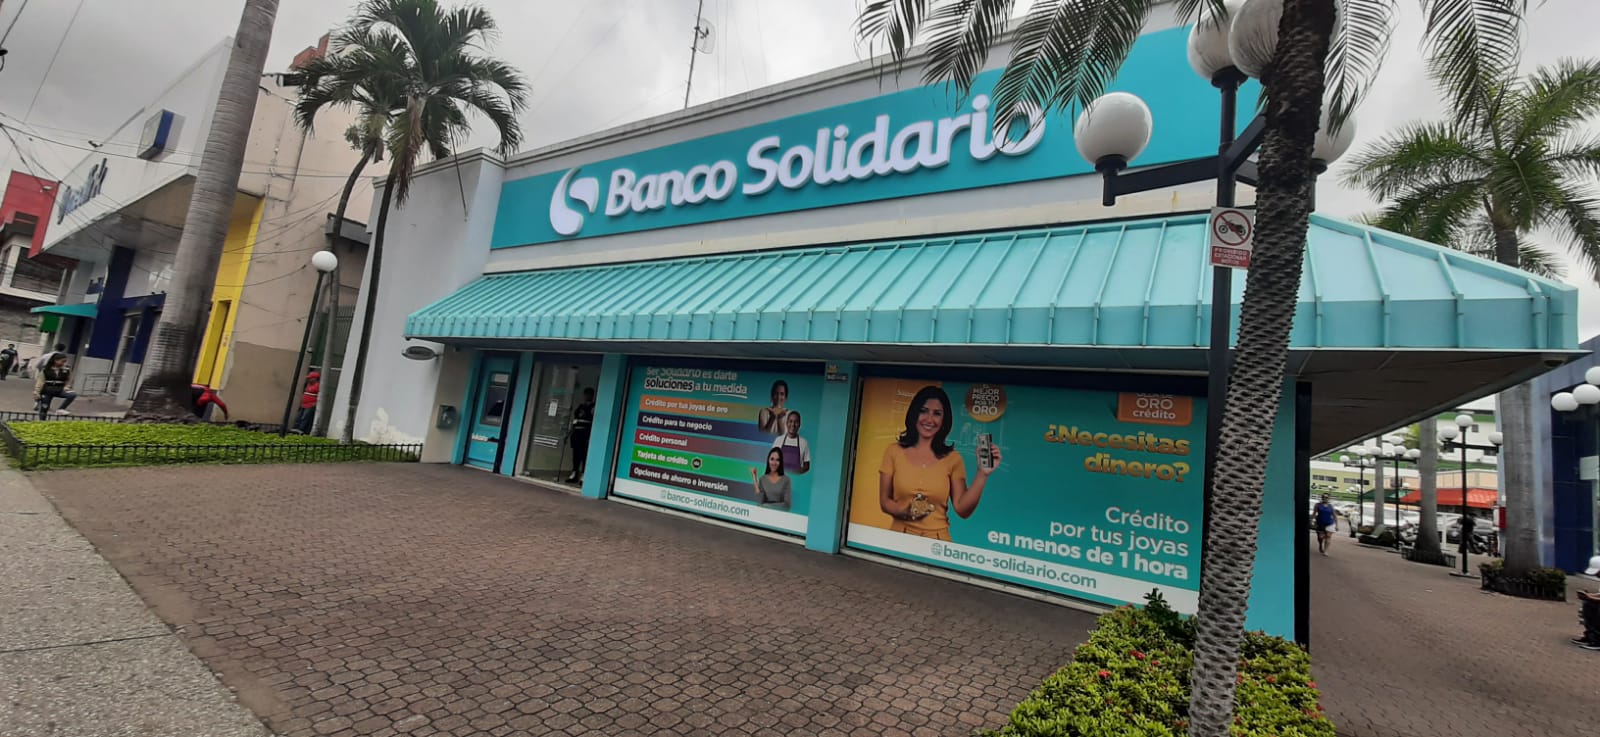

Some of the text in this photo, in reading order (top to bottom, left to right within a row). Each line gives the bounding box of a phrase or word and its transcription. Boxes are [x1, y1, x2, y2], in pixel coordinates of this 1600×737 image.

[605, 94, 1046, 216] Banco Solidario
[702, 371, 712, 379] es
[713, 370, 737, 380] darte
[645, 376, 748, 394] soluciones a tu medida
[645, 398, 666, 408] Crédito
[667, 401, 678, 409] por
[688, 402, 706, 412] joyas
[706, 404, 716, 412] de
[972, 394, 1000, 402] PRECIO
[1136, 397, 1174, 410] ORO
[972, 405, 998, 416] ORO
[1132, 409, 1176, 420] crédito
[642, 415, 663, 425] Crédito
[664, 418, 678, 427] para
[686, 421, 713, 431] negocio
[639, 433, 688, 447] Crédito personal
[1044, 423, 1191, 456] ¿Necesitas
[637, 450, 657, 461] Tarjeta
[657, 453, 666, 461] de
[666, 454, 688, 465] crédito
[1084, 452, 1191, 482] dinero?
[634, 467, 661, 479] Opciones
[661, 472, 671, 481] de
[671, 474, 692, 485] ahorro
[697, 479, 729, 492] inversión
[667, 490, 750, 517] banco-solidario.com
[1105, 506, 1190, 535] Crédito
[1050, 521, 1189, 557] por tus joyas
[987, 530, 1188, 580] en menos de 1 hora
[943, 544, 1097, 589] banco-solidario.com
